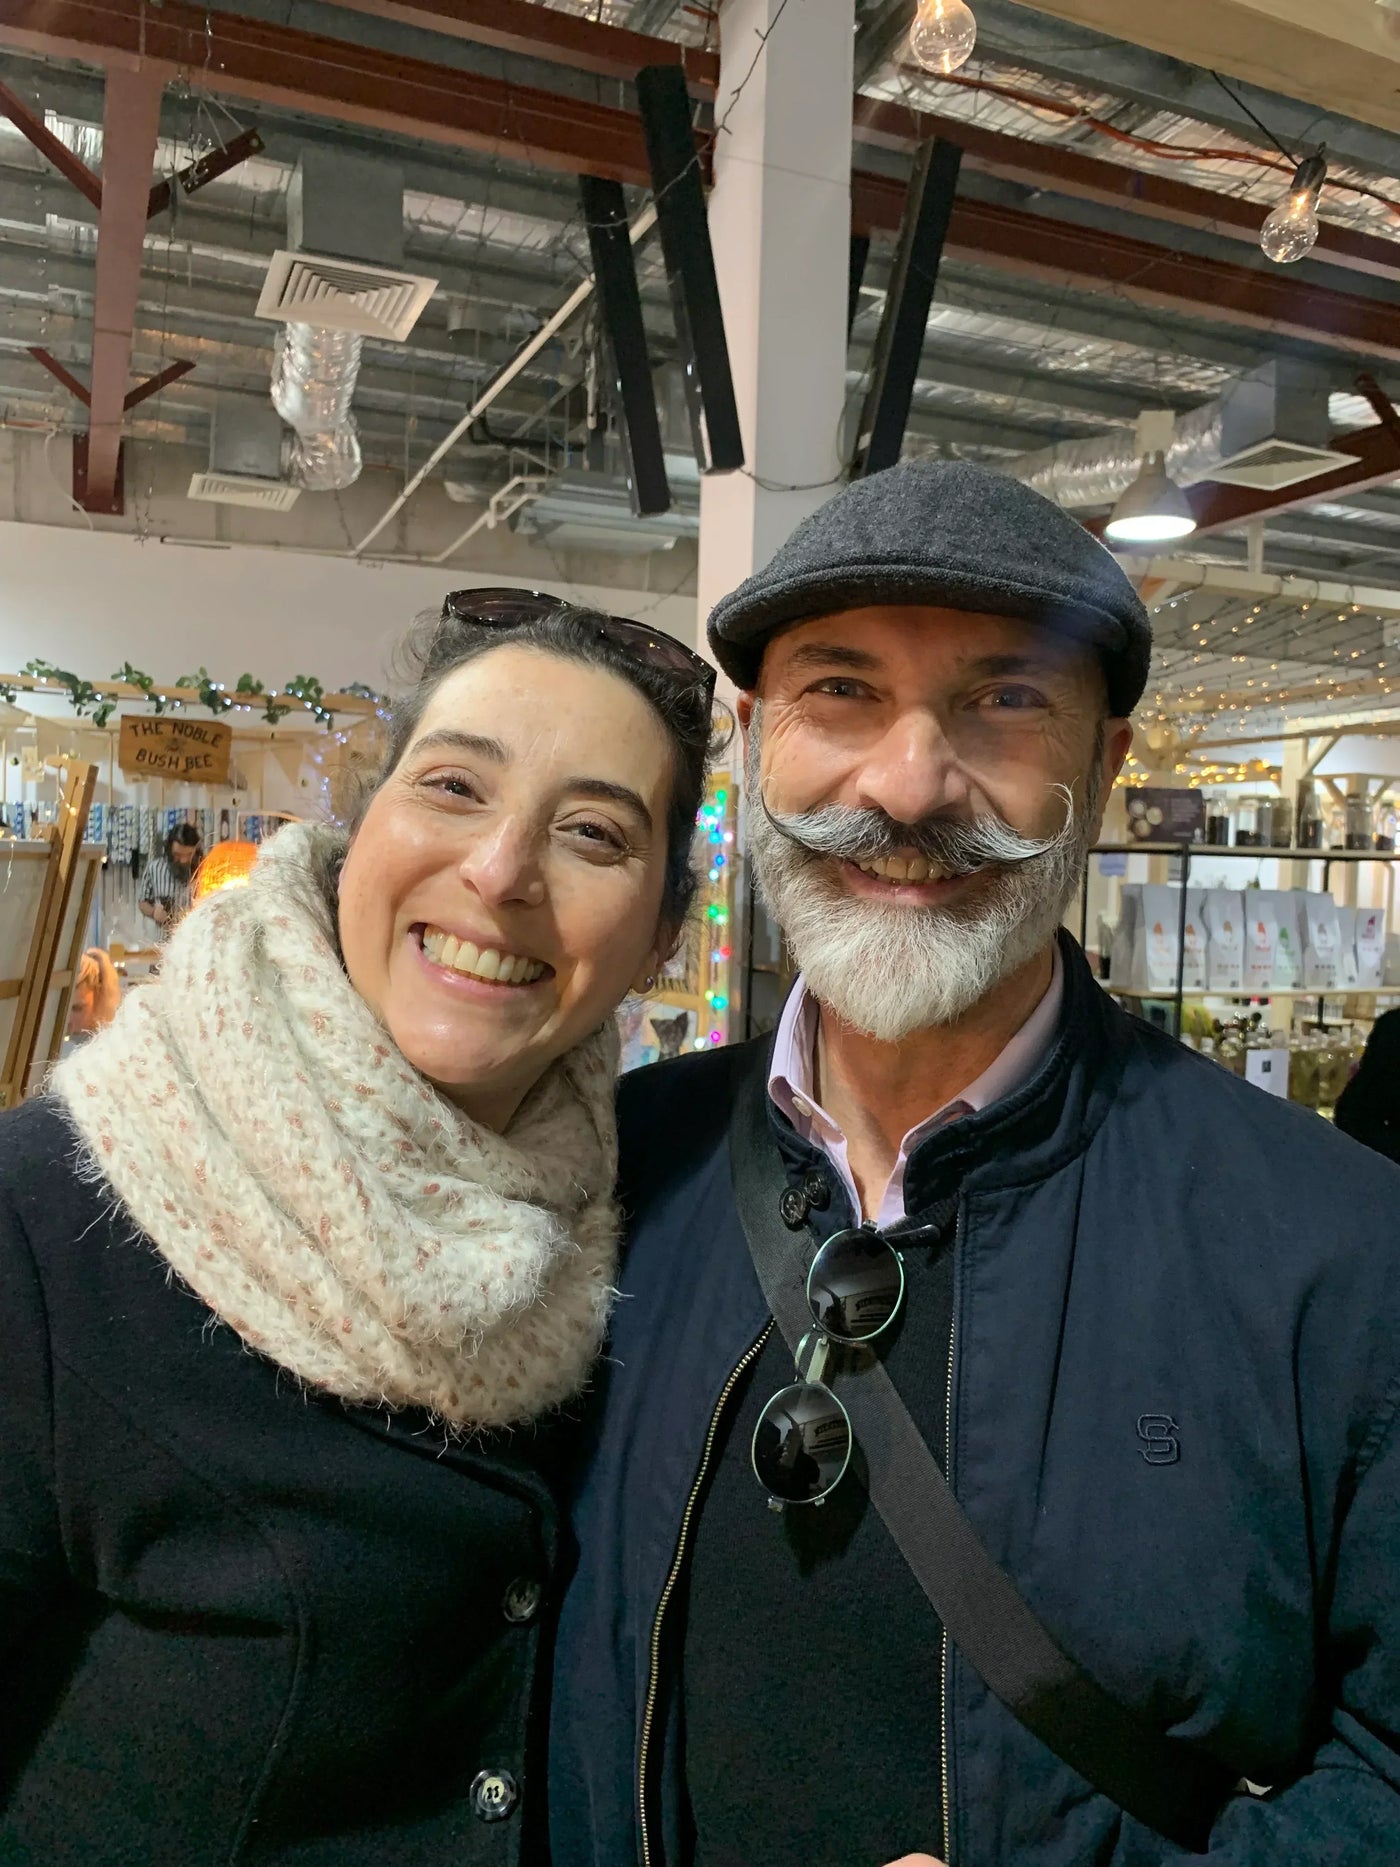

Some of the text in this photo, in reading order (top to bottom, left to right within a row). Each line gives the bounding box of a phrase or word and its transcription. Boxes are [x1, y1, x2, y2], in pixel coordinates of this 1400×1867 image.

[130, 722, 223, 748] THE NOBLE
[136, 748, 212, 769] BUSH BEE
